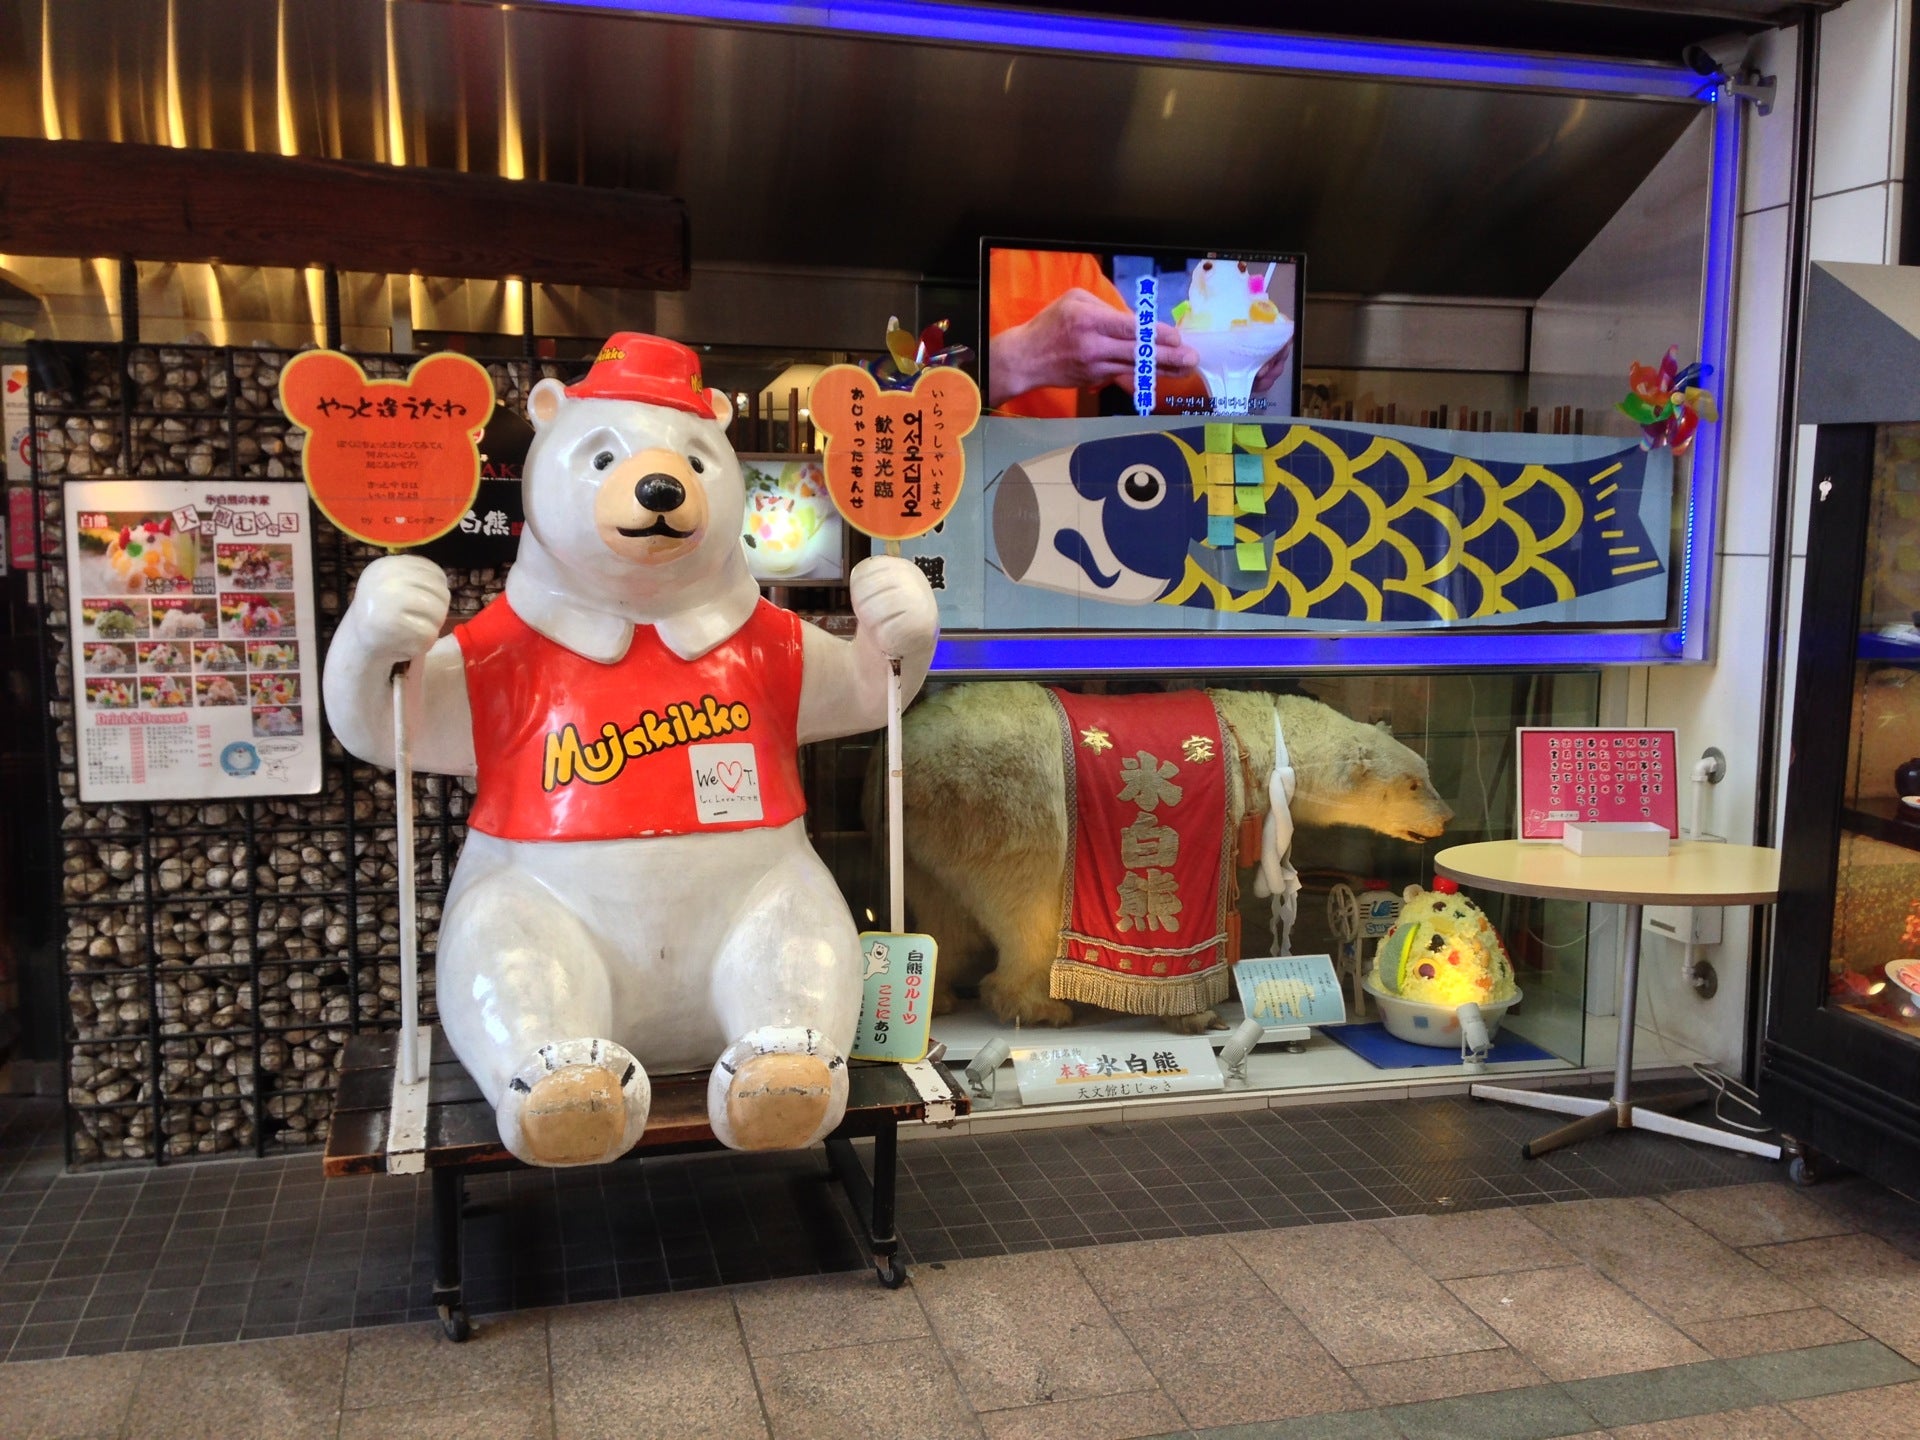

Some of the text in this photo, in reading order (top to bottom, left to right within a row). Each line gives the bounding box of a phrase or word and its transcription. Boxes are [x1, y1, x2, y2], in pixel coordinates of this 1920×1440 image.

[850, 387, 865, 509] おじゃったもんせ
[900, 409, 924, 518] 어서오십시오
[930, 389, 945, 511] いらっしゃいませ
[696, 768, 718, 788] We
[1116, 750, 1183, 933] 氷白熊
[873, 984, 892, 1045] ここにあり
[901, 950, 924, 1025] 白熊のルーツ
[1077, 1080, 1173, 1100] 天文館むじゃき
[1096, 1050, 1182, 1077] 氷白熊
